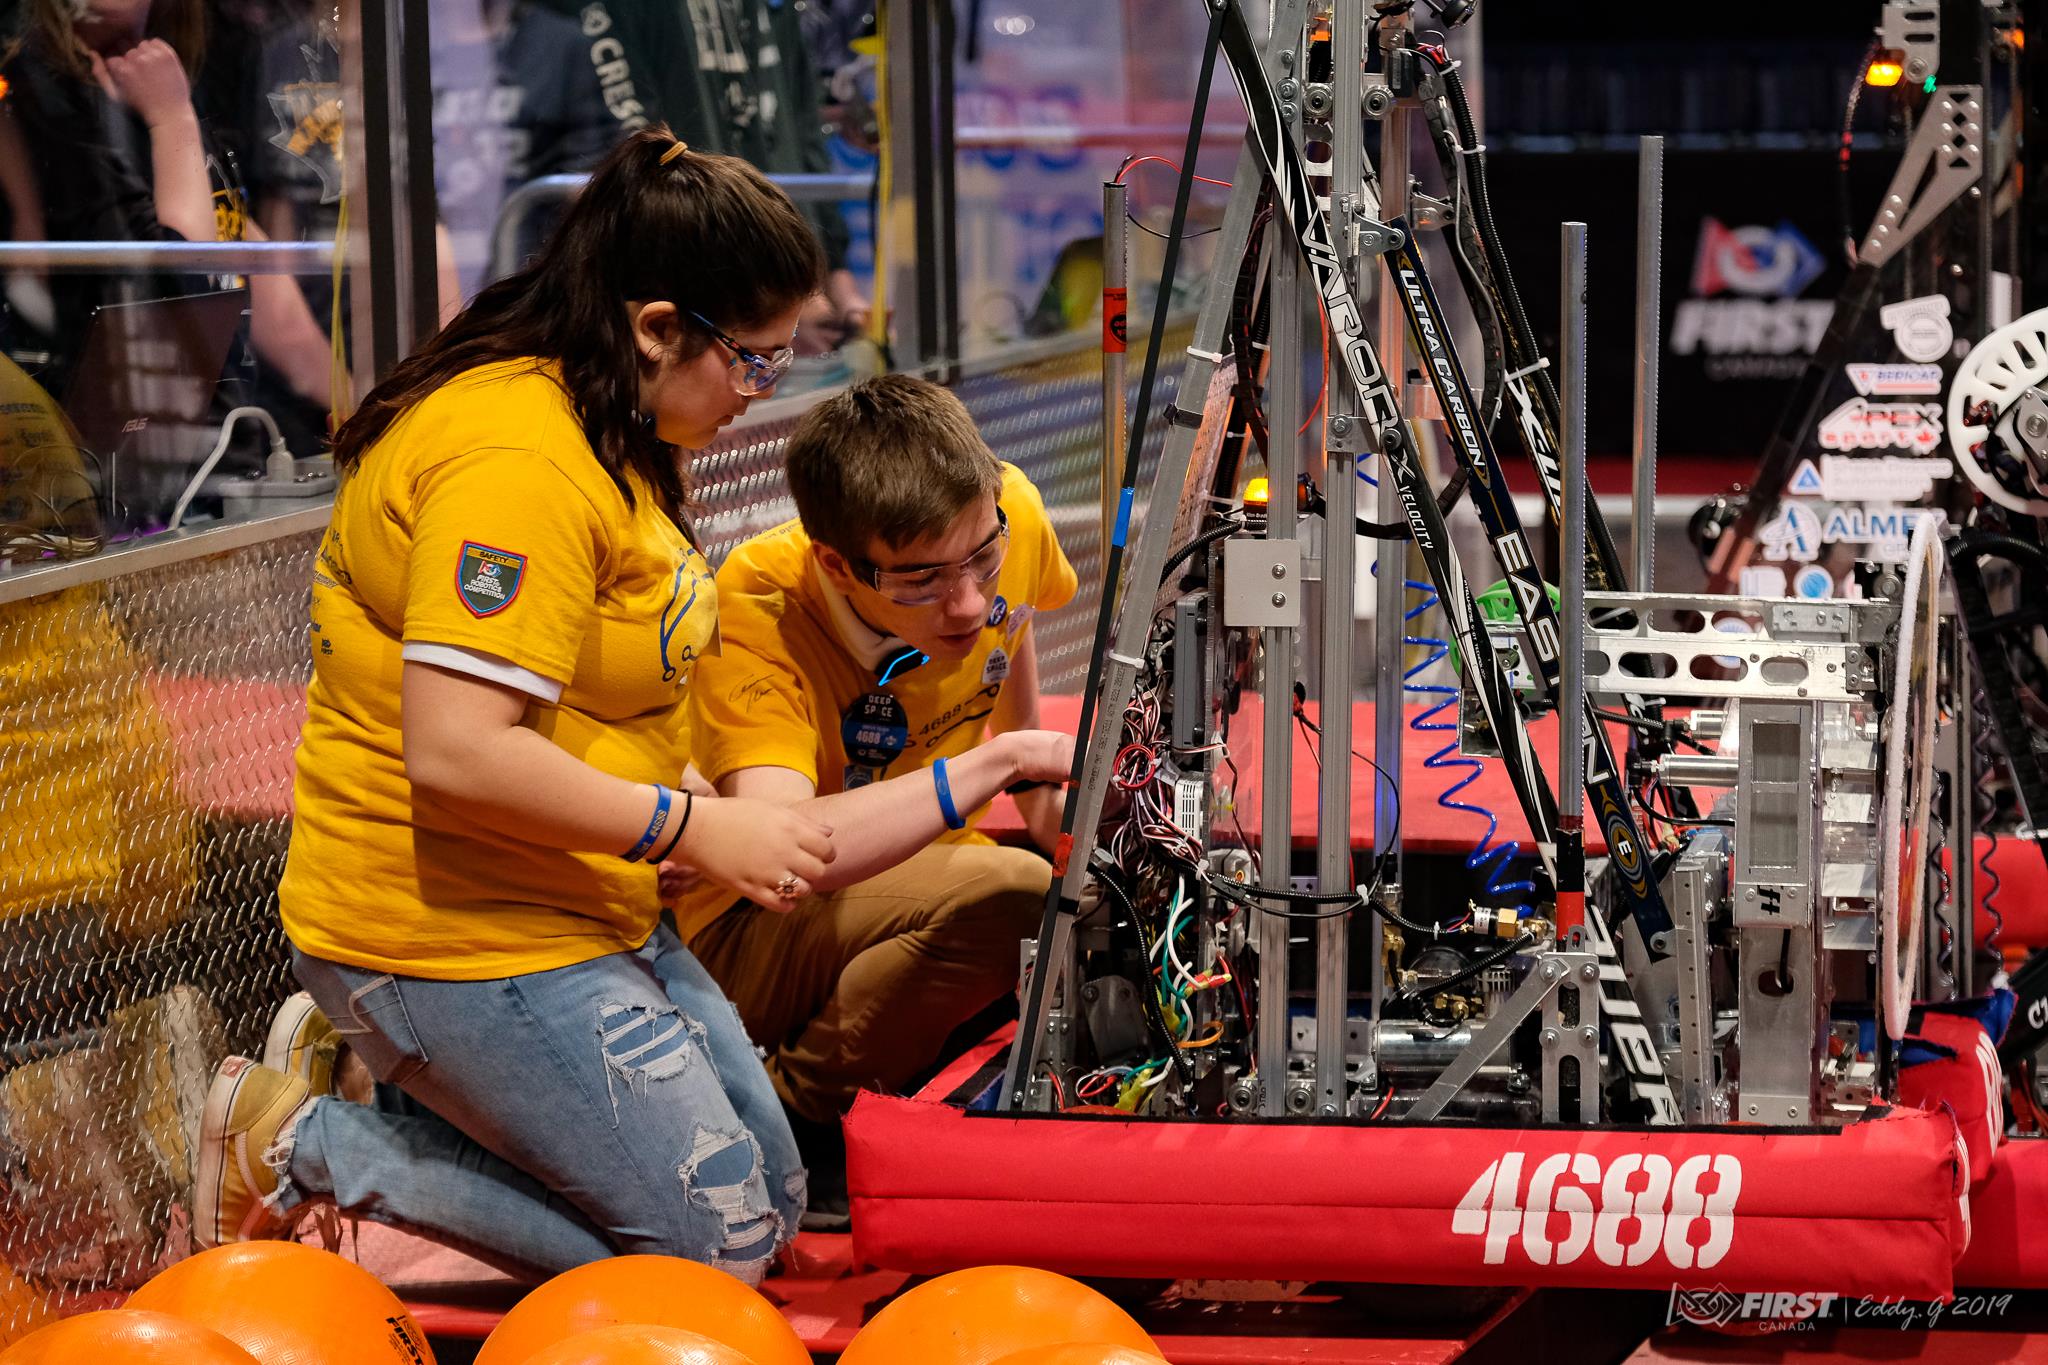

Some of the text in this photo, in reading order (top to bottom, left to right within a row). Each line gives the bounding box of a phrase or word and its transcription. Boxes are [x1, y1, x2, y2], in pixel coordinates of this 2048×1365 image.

[1400, 269, 1485, 467] ULTRA CARBON
[1504, 368, 1562, 509] X-LI
[1398, 485, 1434, 550] VELOCITY
[1828, 514, 1944, 537] ALME
[480, 551, 509, 564] SAFETY
[463, 584, 506, 600] COMPETITION
[470, 579, 502, 593] ROBOTICS
[1496, 531, 1610, 785] EASN
[868, 694, 892, 705] DEEP
[864, 704, 894, 718] SPCE
[855, 729, 881, 745] 4688
[1451, 1151, 1743, 1270] 4688
